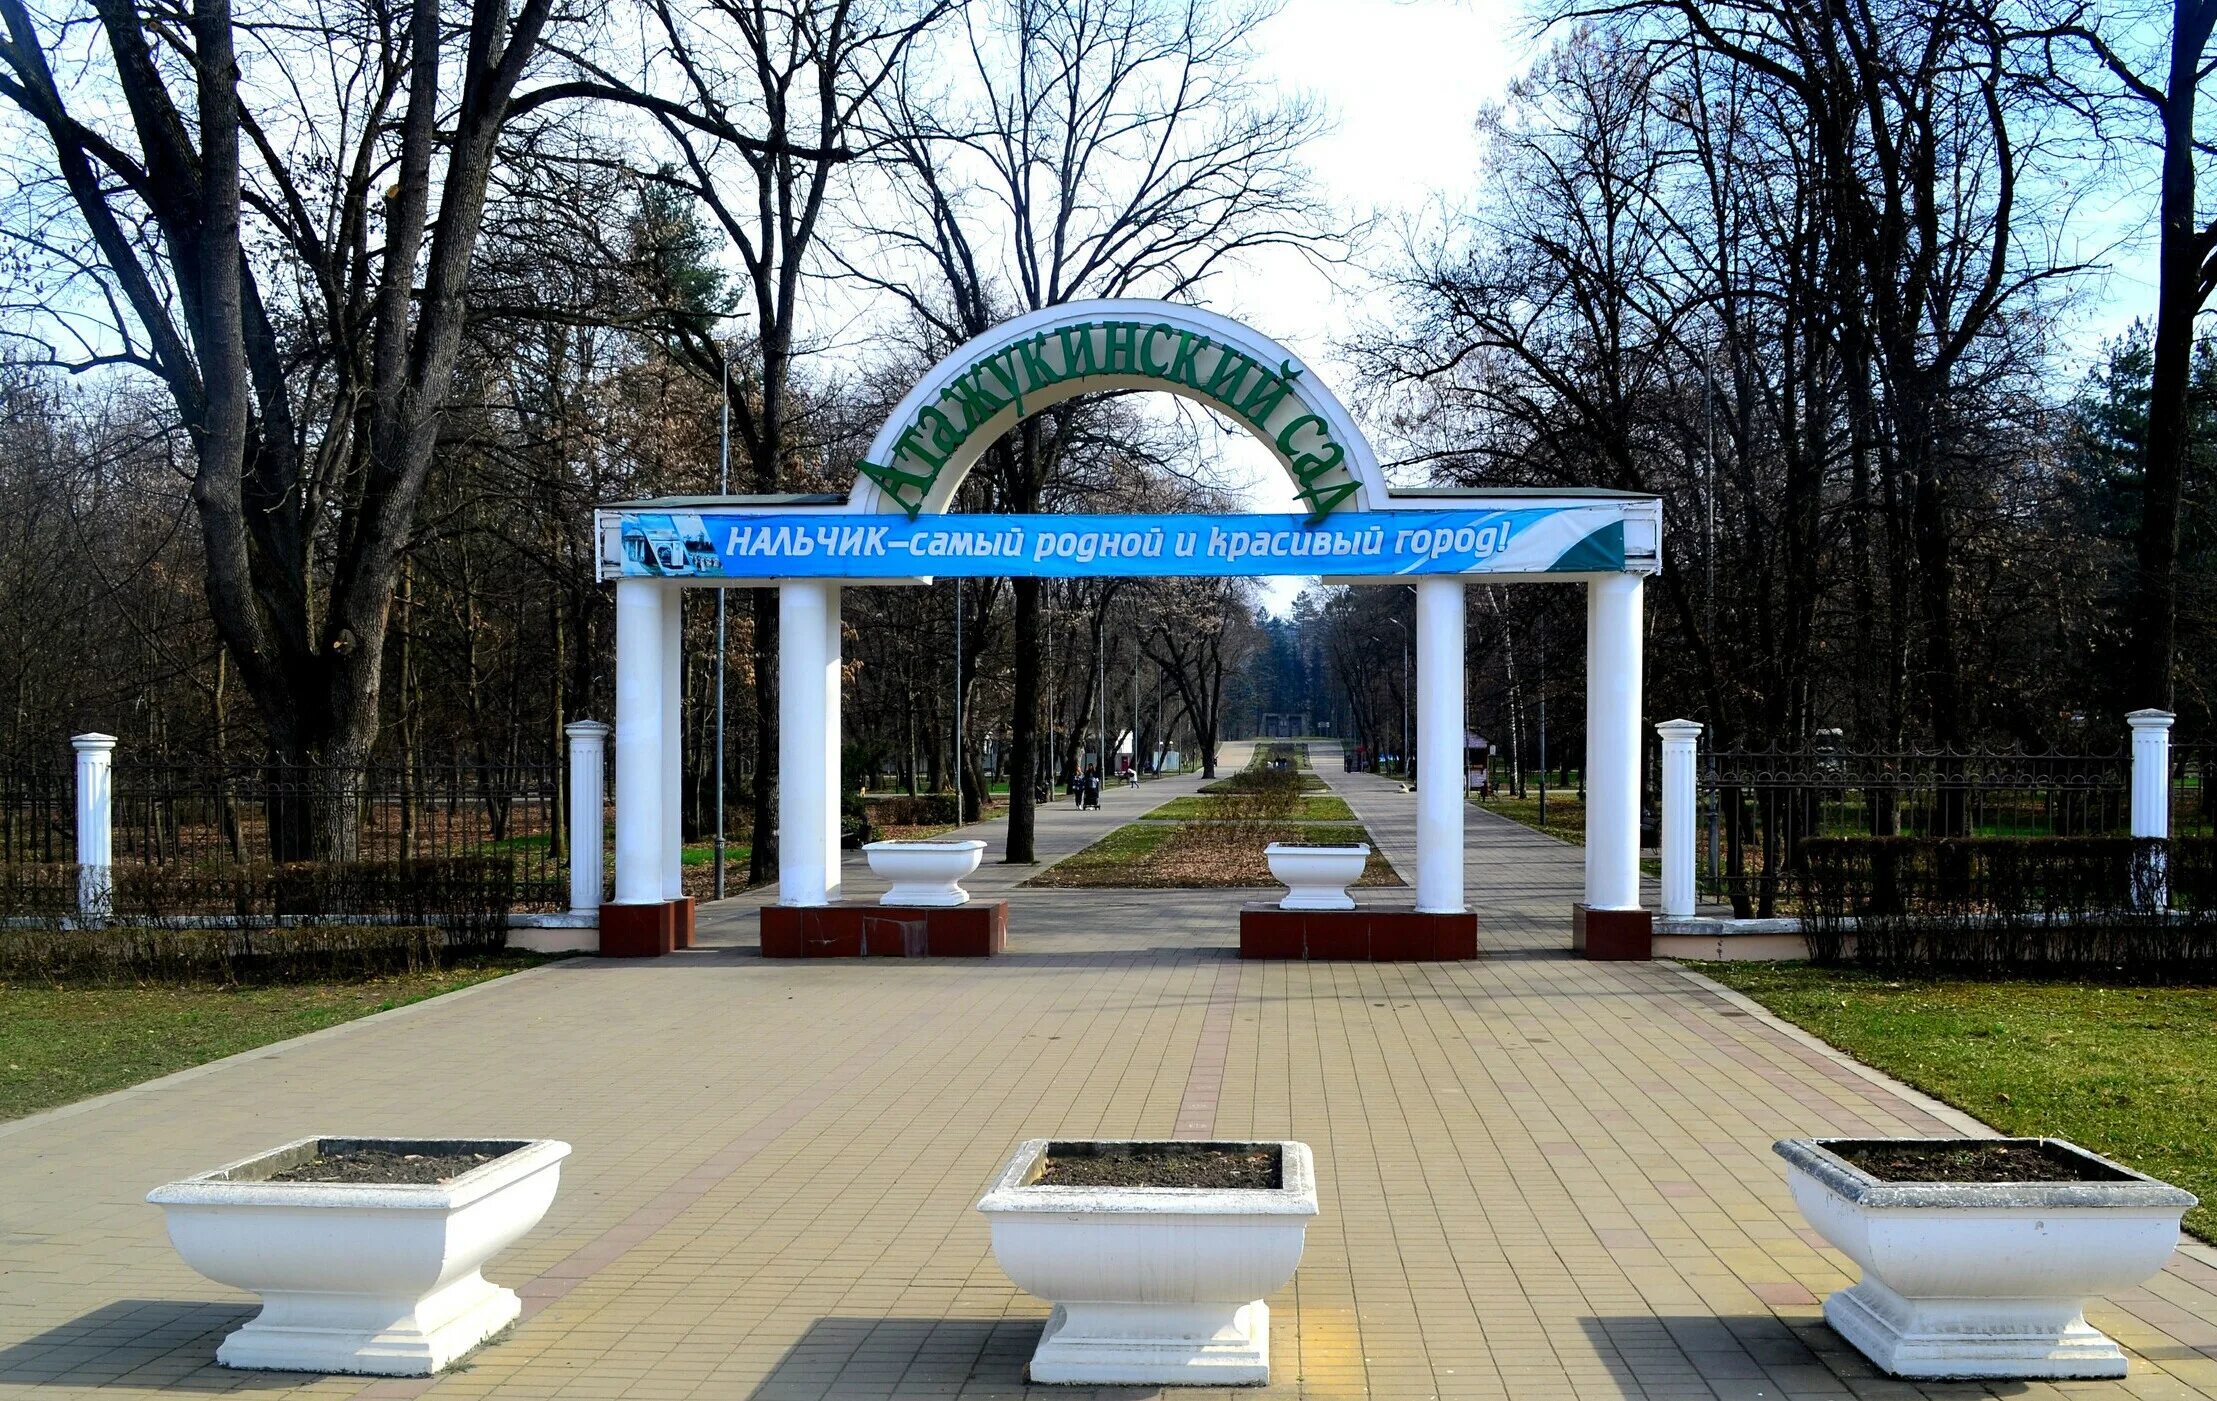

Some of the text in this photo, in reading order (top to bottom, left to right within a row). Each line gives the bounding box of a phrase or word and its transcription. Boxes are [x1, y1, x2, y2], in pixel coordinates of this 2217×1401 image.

[855, 321, 1303, 518] Атажукинский
[1032, 526, 1165, 563] родной
[1174, 533, 1194, 556] и
[1206, 526, 1382, 562] красивый
[1394, 521, 1510, 560] город!
